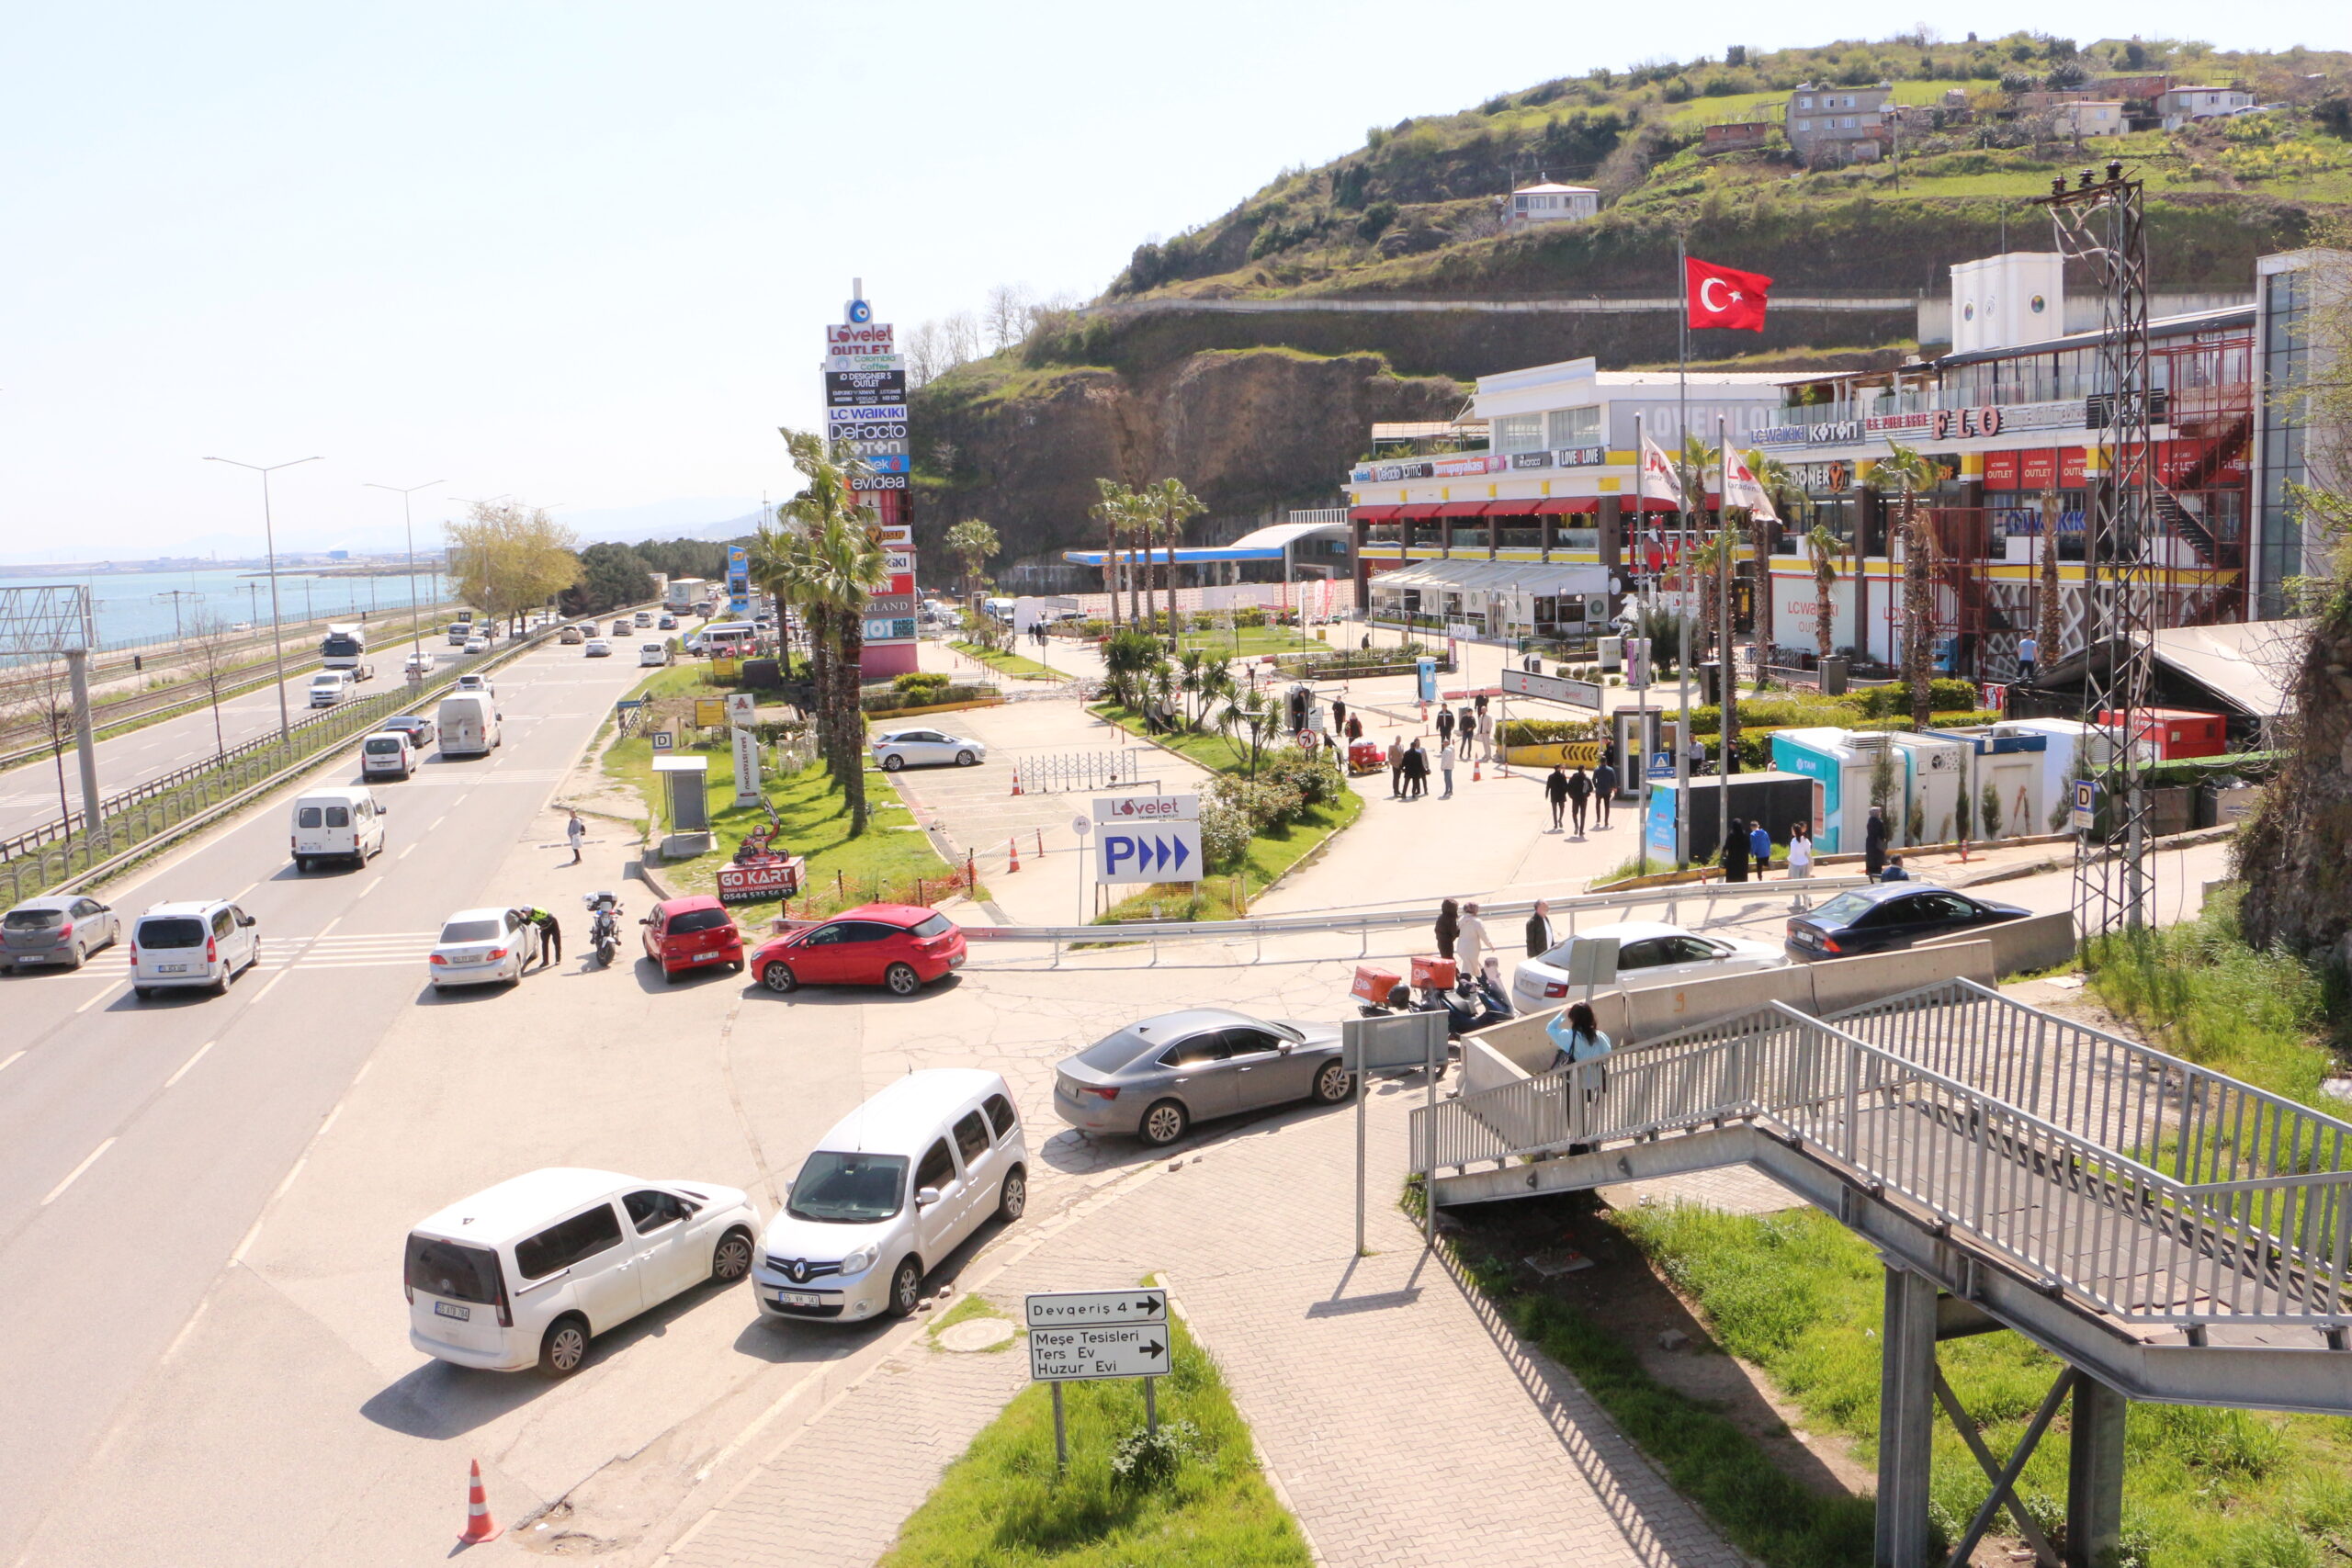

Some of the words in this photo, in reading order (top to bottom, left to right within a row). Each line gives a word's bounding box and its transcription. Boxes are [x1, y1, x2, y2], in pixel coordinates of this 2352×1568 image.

[831, 344, 891, 355] OUTLET
[853, 379, 879, 388] OUTLET
[831, 409, 848, 420] LC
[1932, 405, 2000, 440] FLO
[830, 423, 906, 440] DeFacto
[1792, 465, 1830, 485] DÖNER
[1987, 469, 2013, 479] OUTLET
[2025, 468, 2052, 477] OUTLET
[852, 475, 905, 491] evidea
[658, 737, 667, 745] D
[1804, 761, 1815, 771] TAM
[2079, 788, 2089, 805] D
[1112, 798, 1180, 816] Lovelet
[1105, 836, 1136, 874] P
[721, 873, 743, 886] GO
[748, 868, 791, 885] KART
[1117, 1303, 1127, 1313] 4
[1035, 1334, 1074, 1347] Meşe
[1080, 1330, 1139, 1343] Tesisleri
[1035, 1348, 1066, 1359] Ters
[1078, 1347, 1095, 1359] Ev
[1038, 1362, 1084, 1374] Huzur
[1096, 1360, 1117, 1372] Evi
